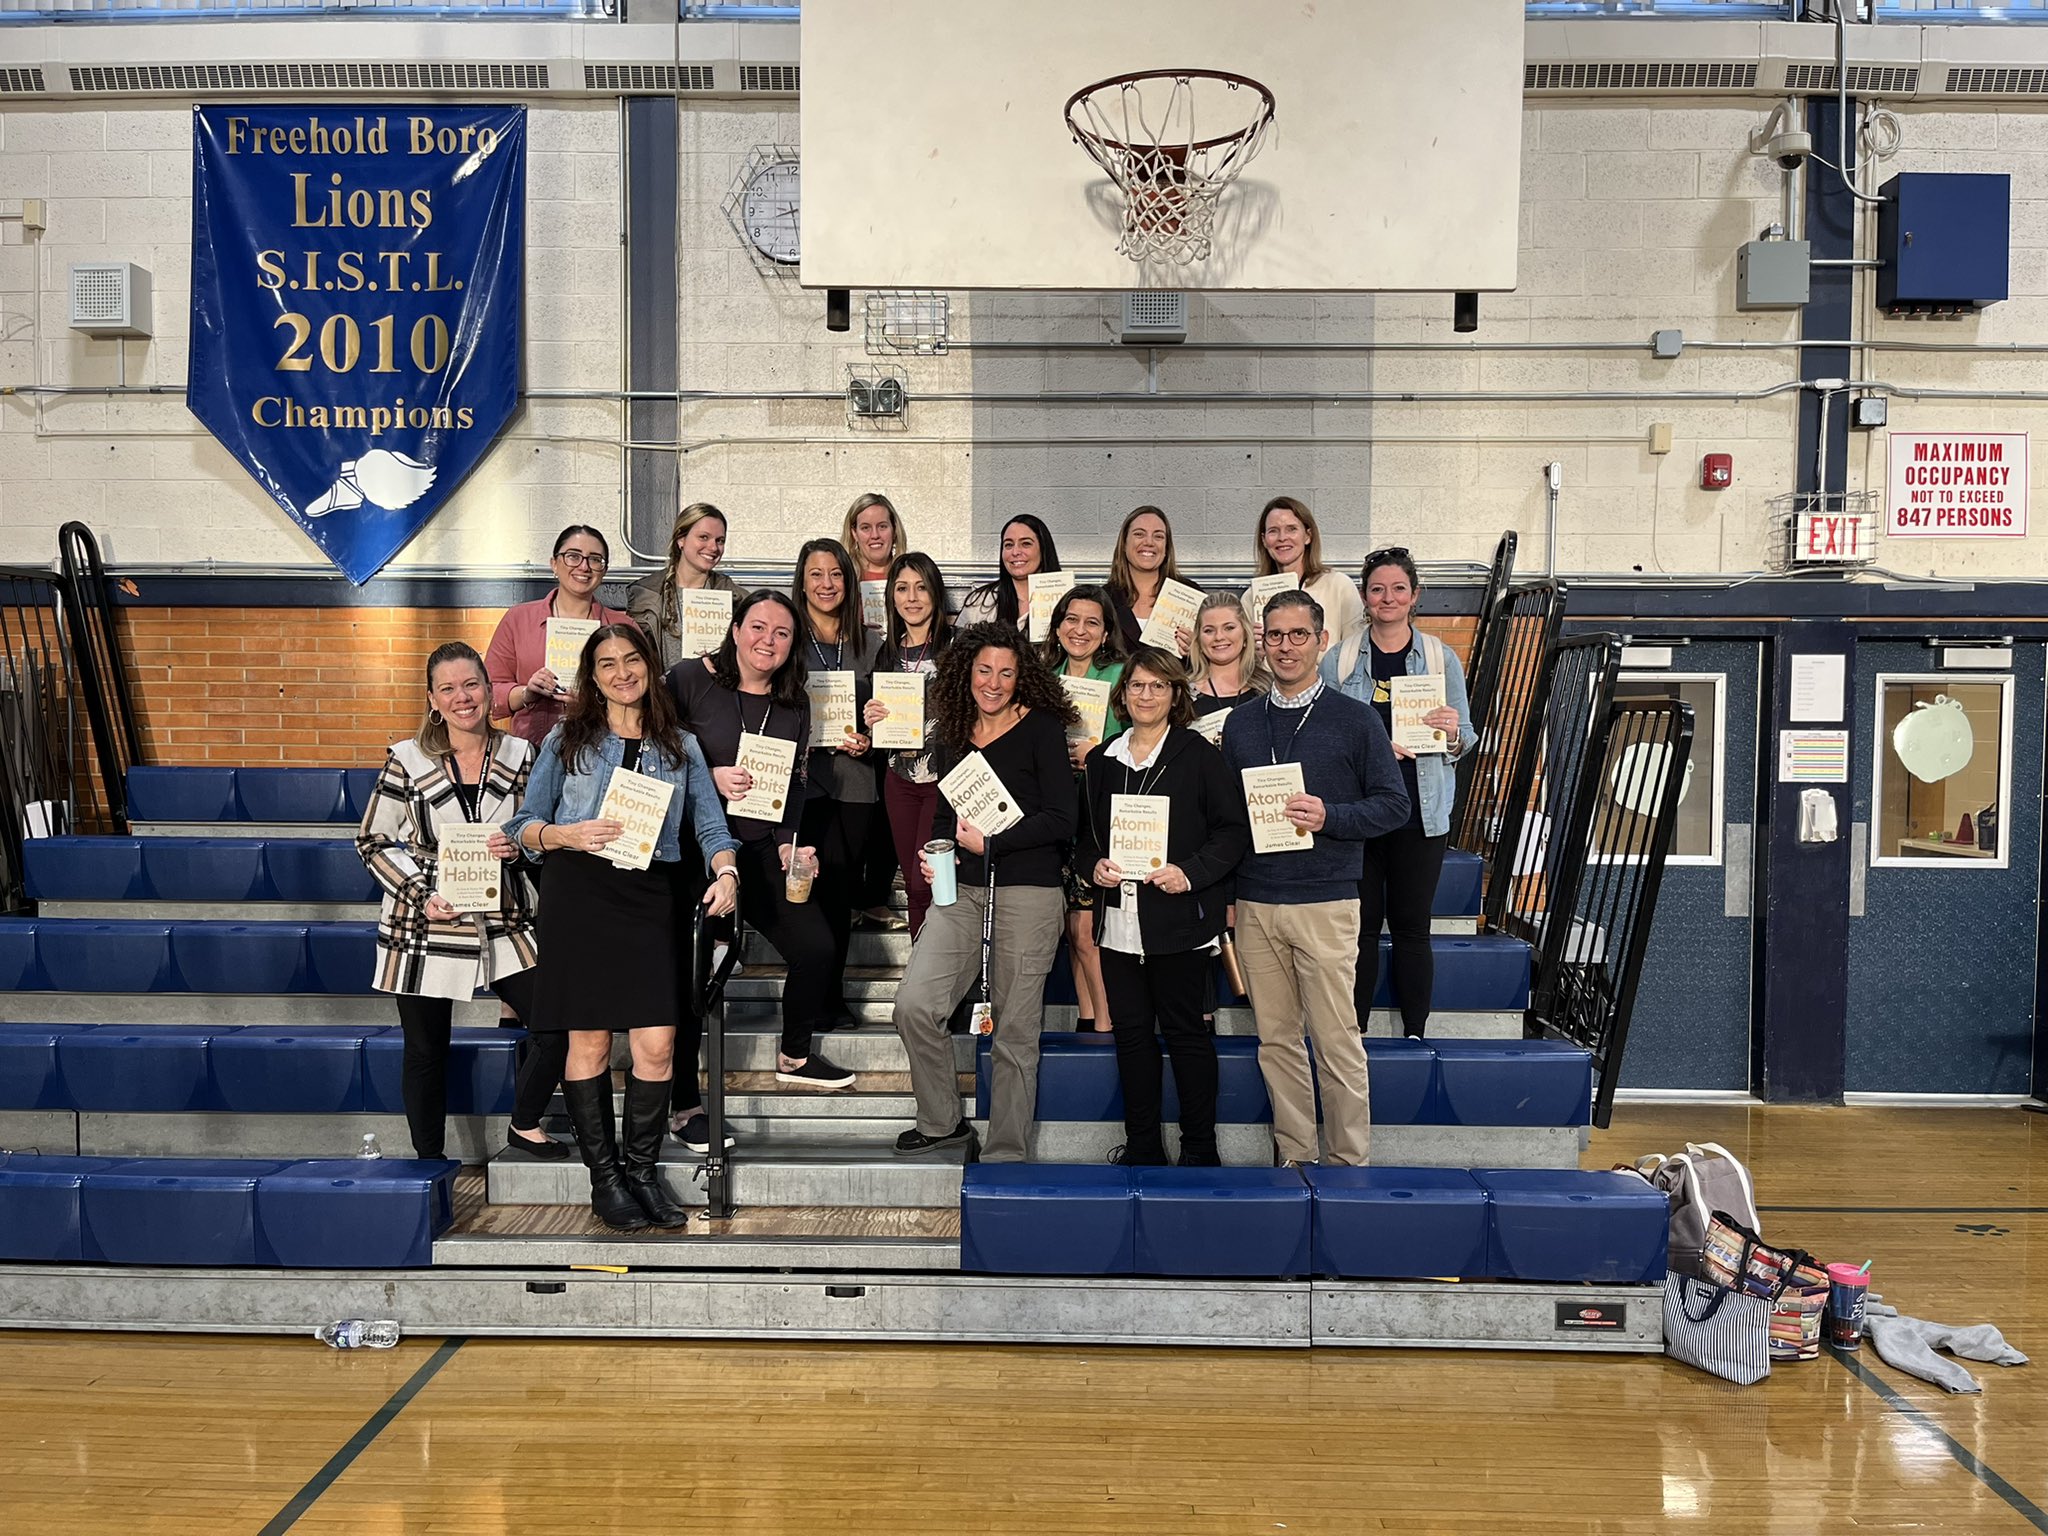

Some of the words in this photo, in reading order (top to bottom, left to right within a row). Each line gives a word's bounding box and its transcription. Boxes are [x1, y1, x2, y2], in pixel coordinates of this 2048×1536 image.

[225, 116, 389, 155] Freehold
[407, 116, 497, 155] Boro
[765, 173, 776, 182] 11
[786, 166, 798, 176] 12
[289, 172, 433, 228] Lions
[751, 187, 763, 197] 10
[749, 207, 755, 217] 9
[754, 228, 761, 238] 8
[789, 248, 797, 257] 6
[256, 250, 463, 292] S.I.S.T.L.
[273, 312, 449, 374] 2010
[252, 396, 474, 435] Champions
[1914, 443, 2003, 462] MAXIMUM
[1905, 467, 2010, 485] OCCUPANCY
[1911, 490, 1932, 503] NOT
[1939, 490, 1953, 503] TO
[1960, 490, 2004, 503] EXCEED
[1897, 508, 1932, 526] 847
[1936, 508, 2013, 526] PERSONS
[1809, 516, 1862, 555] EXIT
[864, 597, 885, 609] Ato
[685, 606, 732, 620] Atomic
[686, 622, 728, 636] Habits
[549, 653, 580, 668] Hab
[1392, 695, 1444, 709] Atomic
[1395, 713, 1424, 727] Hab
[739, 754, 792, 776] Atomic
[752, 776, 786, 794] abits
[950, 771, 991, 809] Atomic
[607, 788, 667, 820] Atomic
[961, 788, 1000, 820] Habits
[1247, 788, 1294, 806] Atomi
[739, 807, 757, 815] James
[758, 809, 773, 817] Clear
[1252, 808, 1292, 825] Hab
[1110, 815, 1165, 832] Atomic
[1113, 834, 1162, 851] Habits
[441, 847, 501, 862] Atomic
[603, 844, 621, 855] James
[622, 850, 640, 860] Clear
[444, 867, 498, 882] Habits
